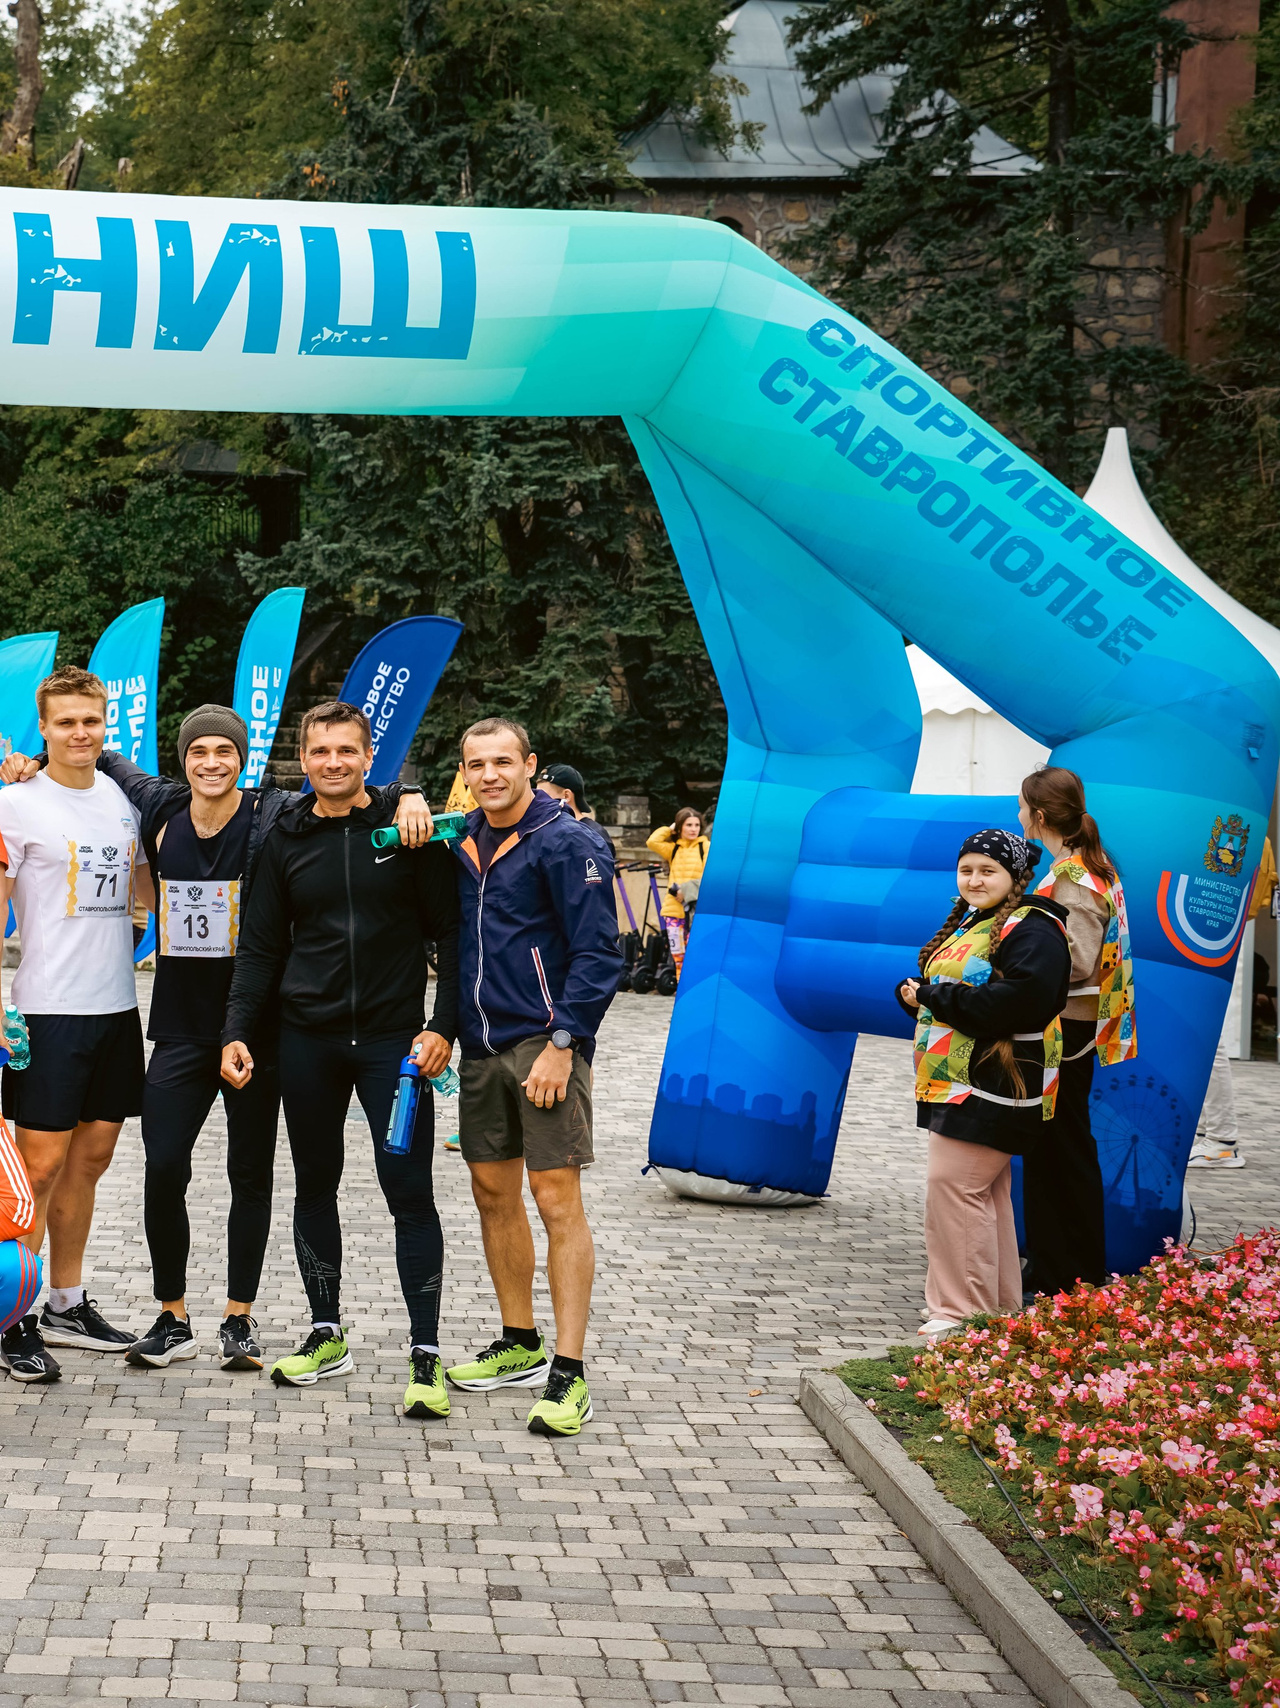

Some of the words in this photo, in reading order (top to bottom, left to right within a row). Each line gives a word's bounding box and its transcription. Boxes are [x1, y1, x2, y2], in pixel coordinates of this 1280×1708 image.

[806, 318, 1193, 618] СПОРТИВНОЕ
[759, 357, 1158, 666] СТАВРОПОЛЬЕ
[362, 661, 393, 718] ОВОЕ
[95, 873, 117, 897] 71
[1194, 877, 1241, 897] МИНИСТЕРСТВО
[1189, 897, 1217, 909] КУЛЬТУРЫ
[1201, 890, 1233, 904] ФИЗИЧЕСКОЙ
[1188, 905, 1235, 924] СТАВРОПОЛЬСКОГО
[1206, 920, 1219, 928] КРАЯ
[183, 914, 209, 939] 13
